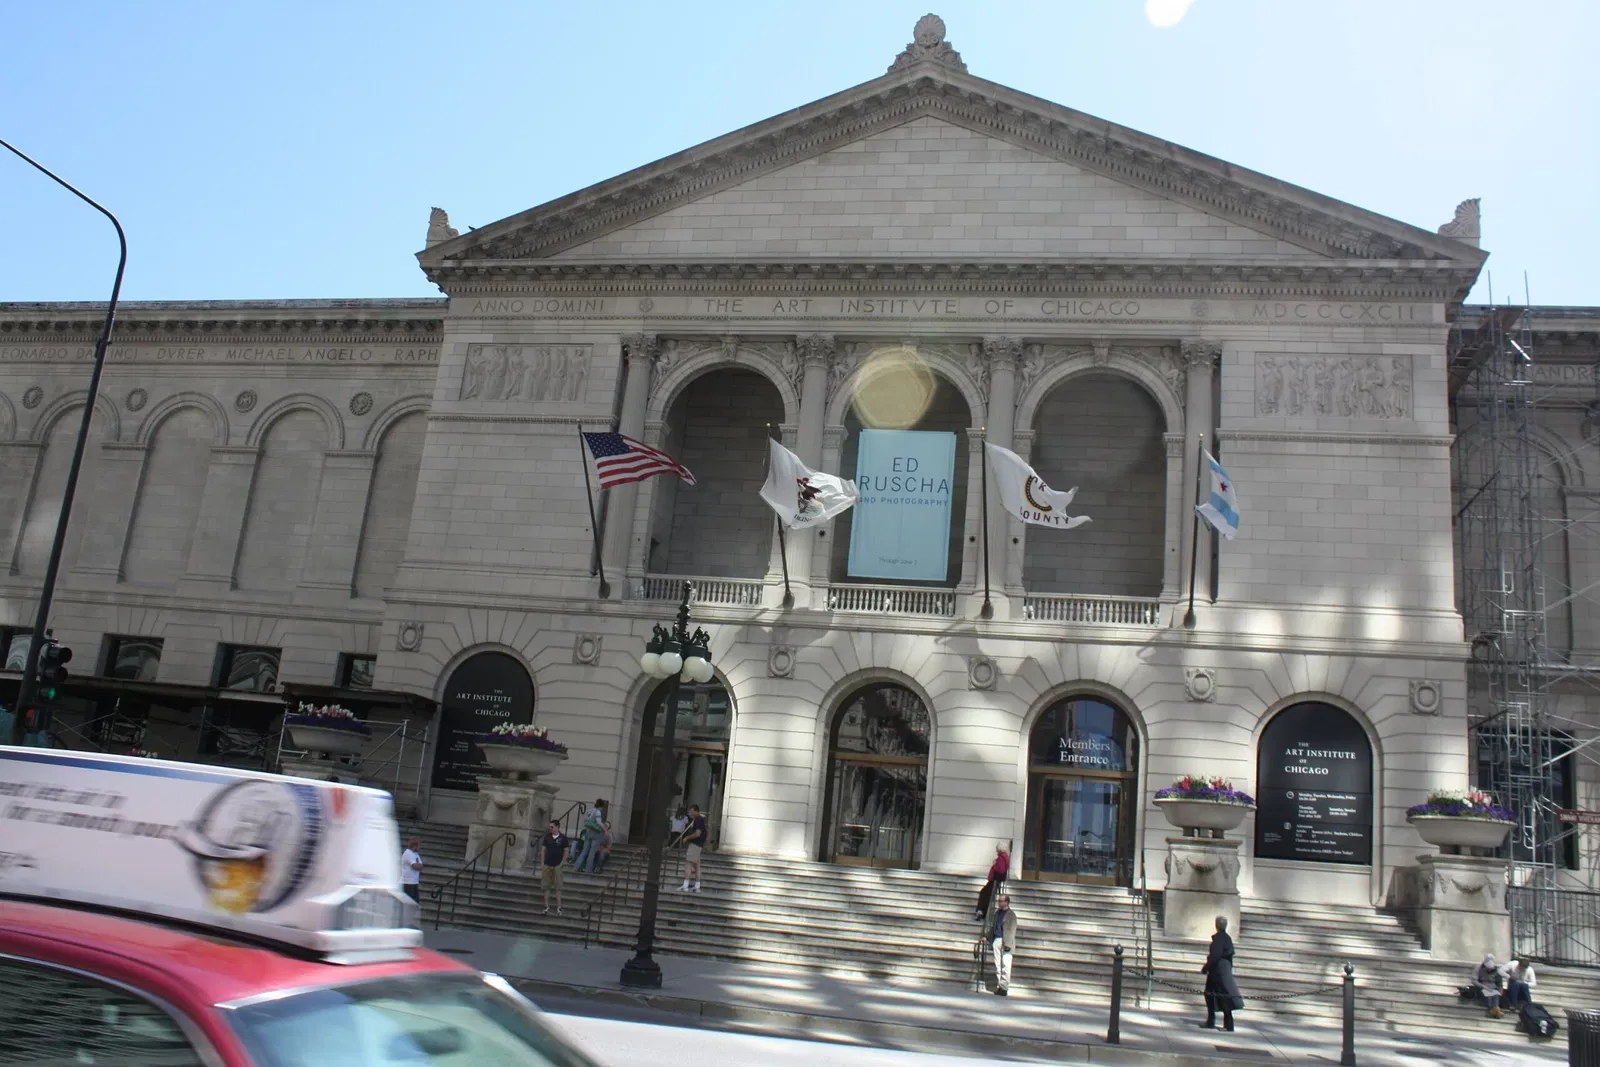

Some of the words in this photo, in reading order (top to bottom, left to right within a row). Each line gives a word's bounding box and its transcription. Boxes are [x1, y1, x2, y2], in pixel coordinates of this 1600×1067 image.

[472, 299, 525, 313] ANNO
[532, 300, 605, 313] DOMINI
[705, 299, 744, 314] THE
[772, 299, 814, 314] ART
[839, 299, 958, 314] INSTITVTE
[984, 300, 1015, 315] OF
[1041, 300, 1141, 316] CHICAGO
[107, 348, 138, 361] INCI
[156, 348, 205, 361] DVRER
[225, 348, 295, 361] MICHAEL
[303, 348, 373, 362] ANGELO
[893, 457, 919, 473] ED
[858, 475, 949, 494] RUSCHA
[880, 497, 949, 507] PHOTOGRAPHY
[1020, 507, 1069, 525] OUNTY
[456, 692, 471, 700] ART
[473, 693, 512, 703] INSTITUTE
[475, 708, 511, 718] CHICAGO
[1060, 737, 1111, 751] Members
[1060, 751, 1109, 765] Entrance
[1285, 748, 1304, 756] ART
[1307, 749, 1356, 760] INSTITUTE
[1284, 765, 1329, 775] CHICAGO
